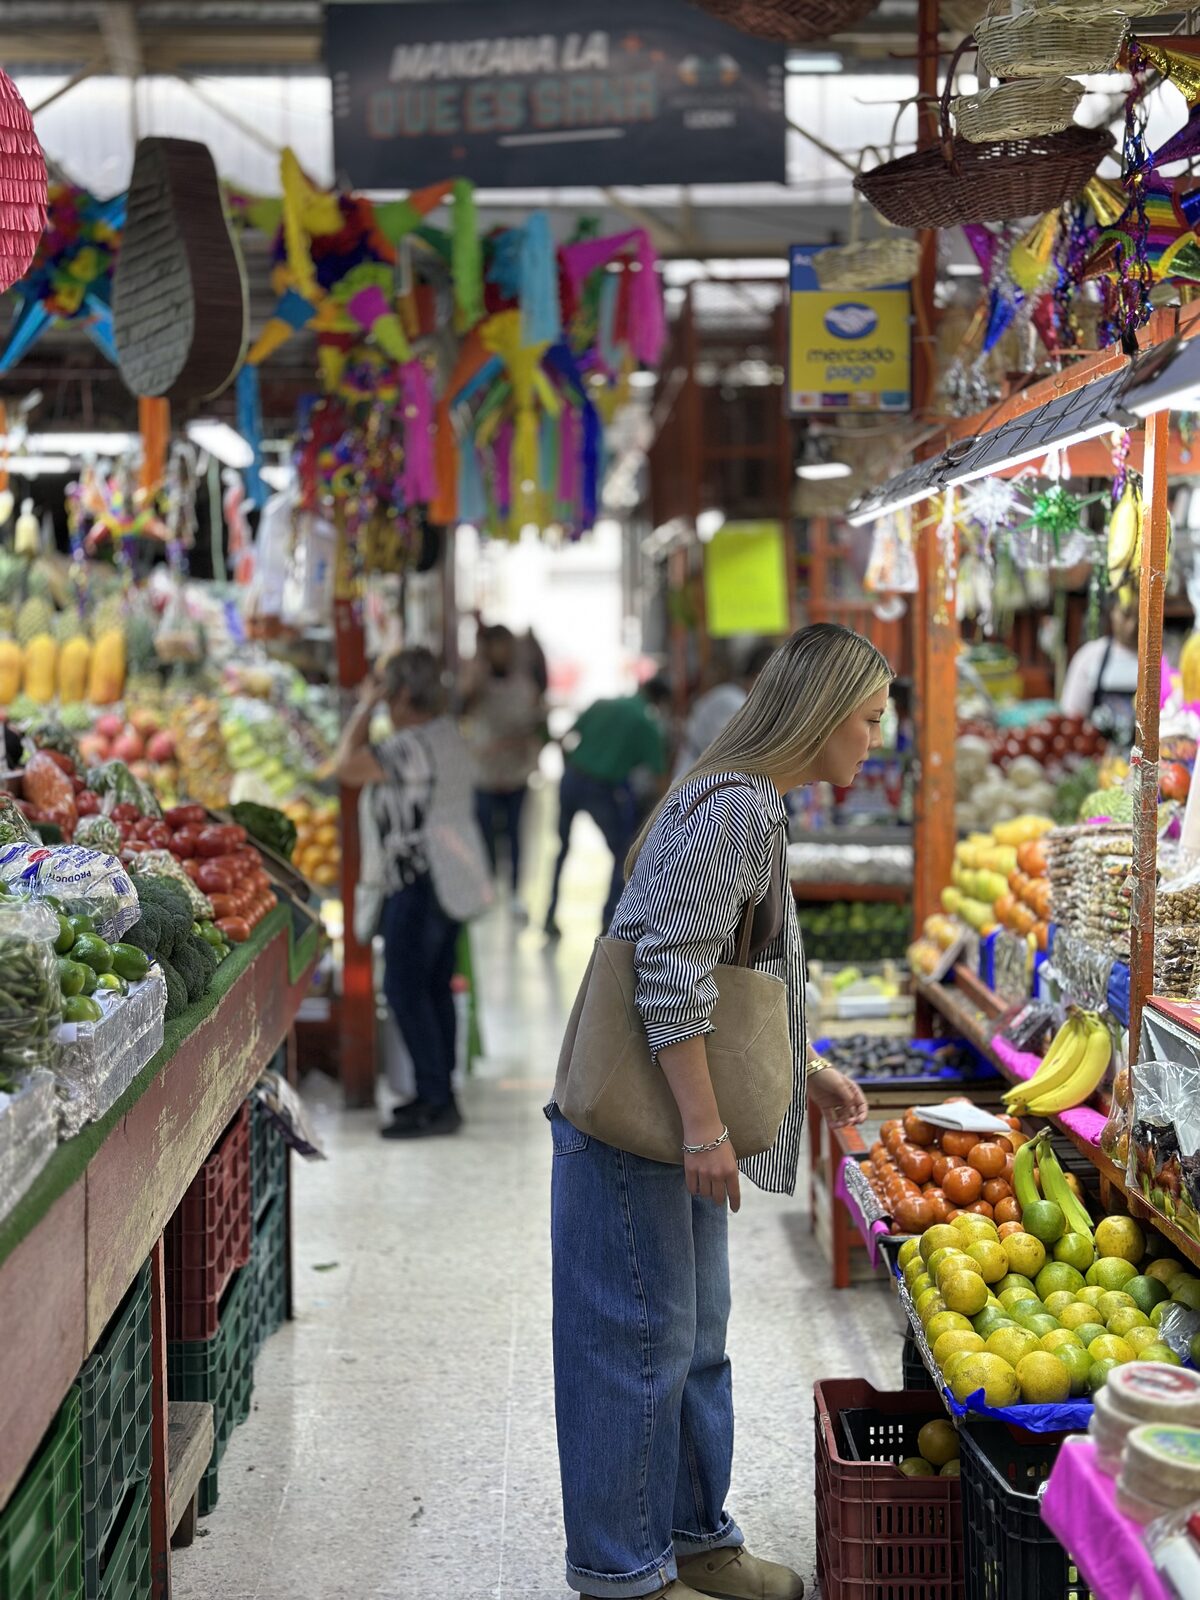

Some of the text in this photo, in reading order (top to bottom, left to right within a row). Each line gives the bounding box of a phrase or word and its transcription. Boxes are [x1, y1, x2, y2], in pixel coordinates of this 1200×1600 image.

[562, 31, 610, 71] LA
[367, 84, 460, 138] QUE
[466, 79, 525, 133] ES
[808, 346, 893, 362] mercado
[826, 365, 875, 382] pago
